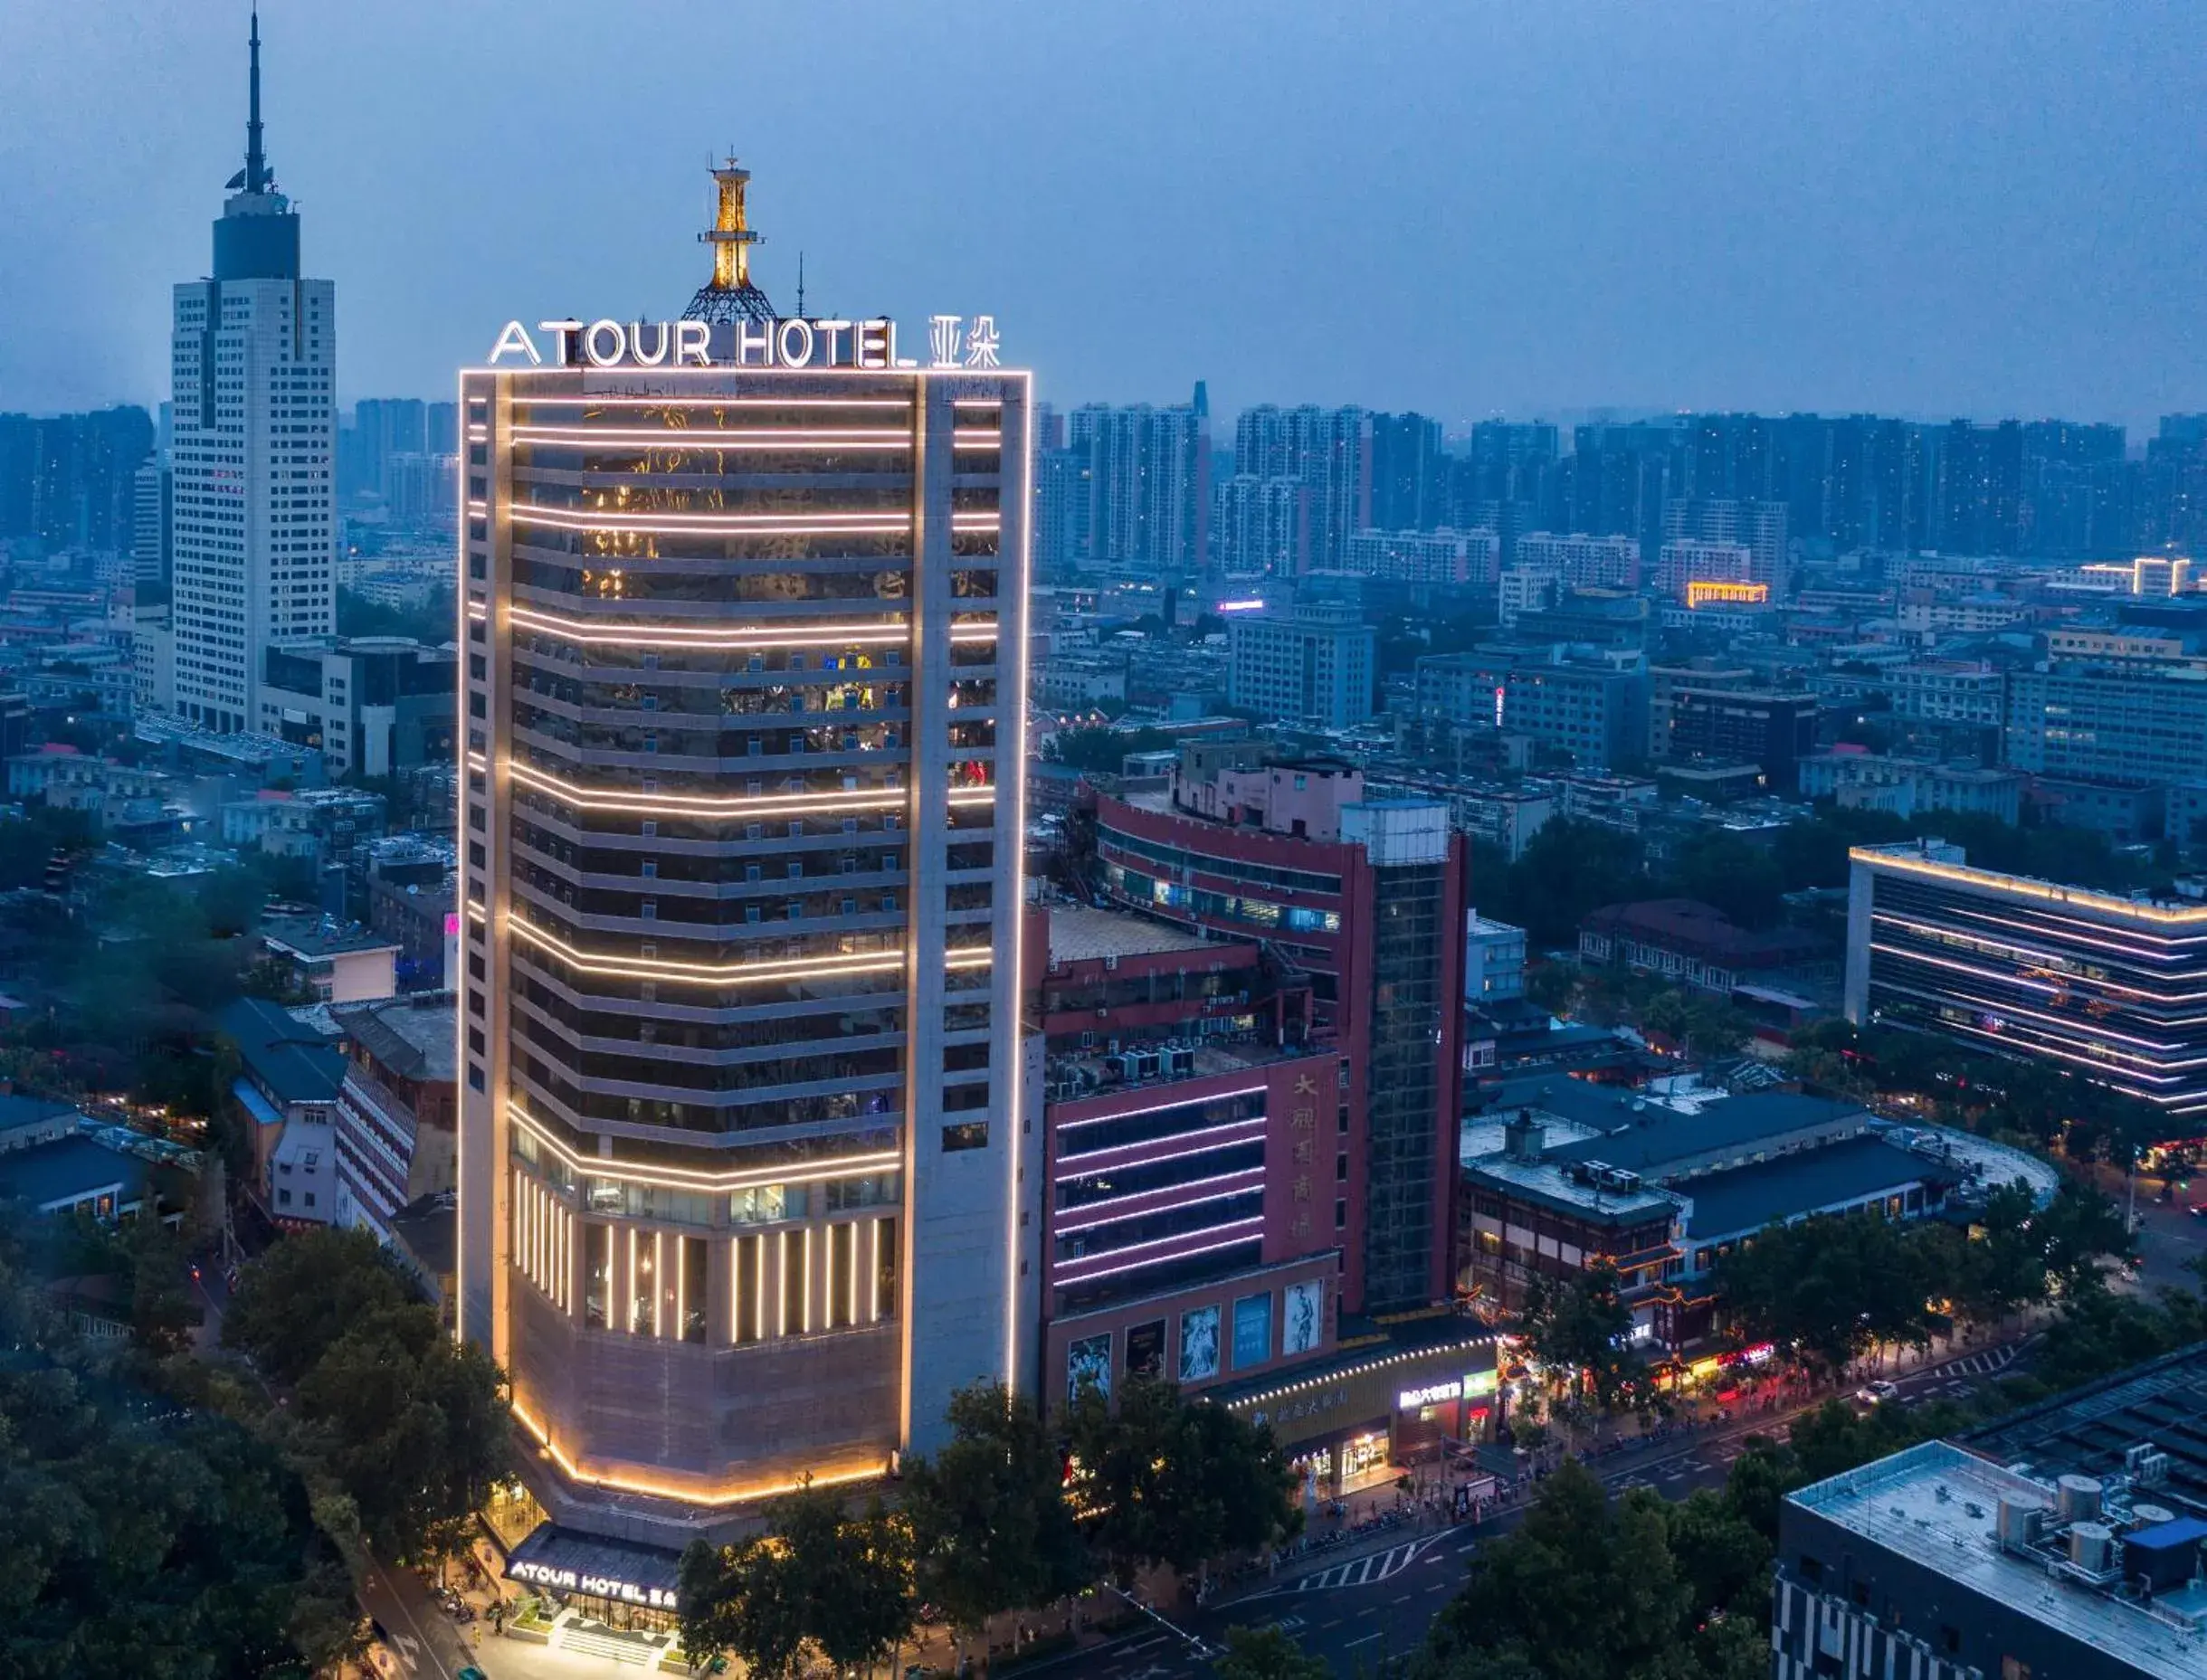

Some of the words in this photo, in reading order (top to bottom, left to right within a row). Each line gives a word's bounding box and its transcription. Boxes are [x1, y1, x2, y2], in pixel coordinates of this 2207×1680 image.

[490, 319, 711, 367] ATOUR
[737, 318, 918, 368] HOTEL
[928, 315, 1001, 369] 亚朵
[510, 1561, 576, 1587] ATOUR
[582, 1575, 646, 1600] HOTEL
